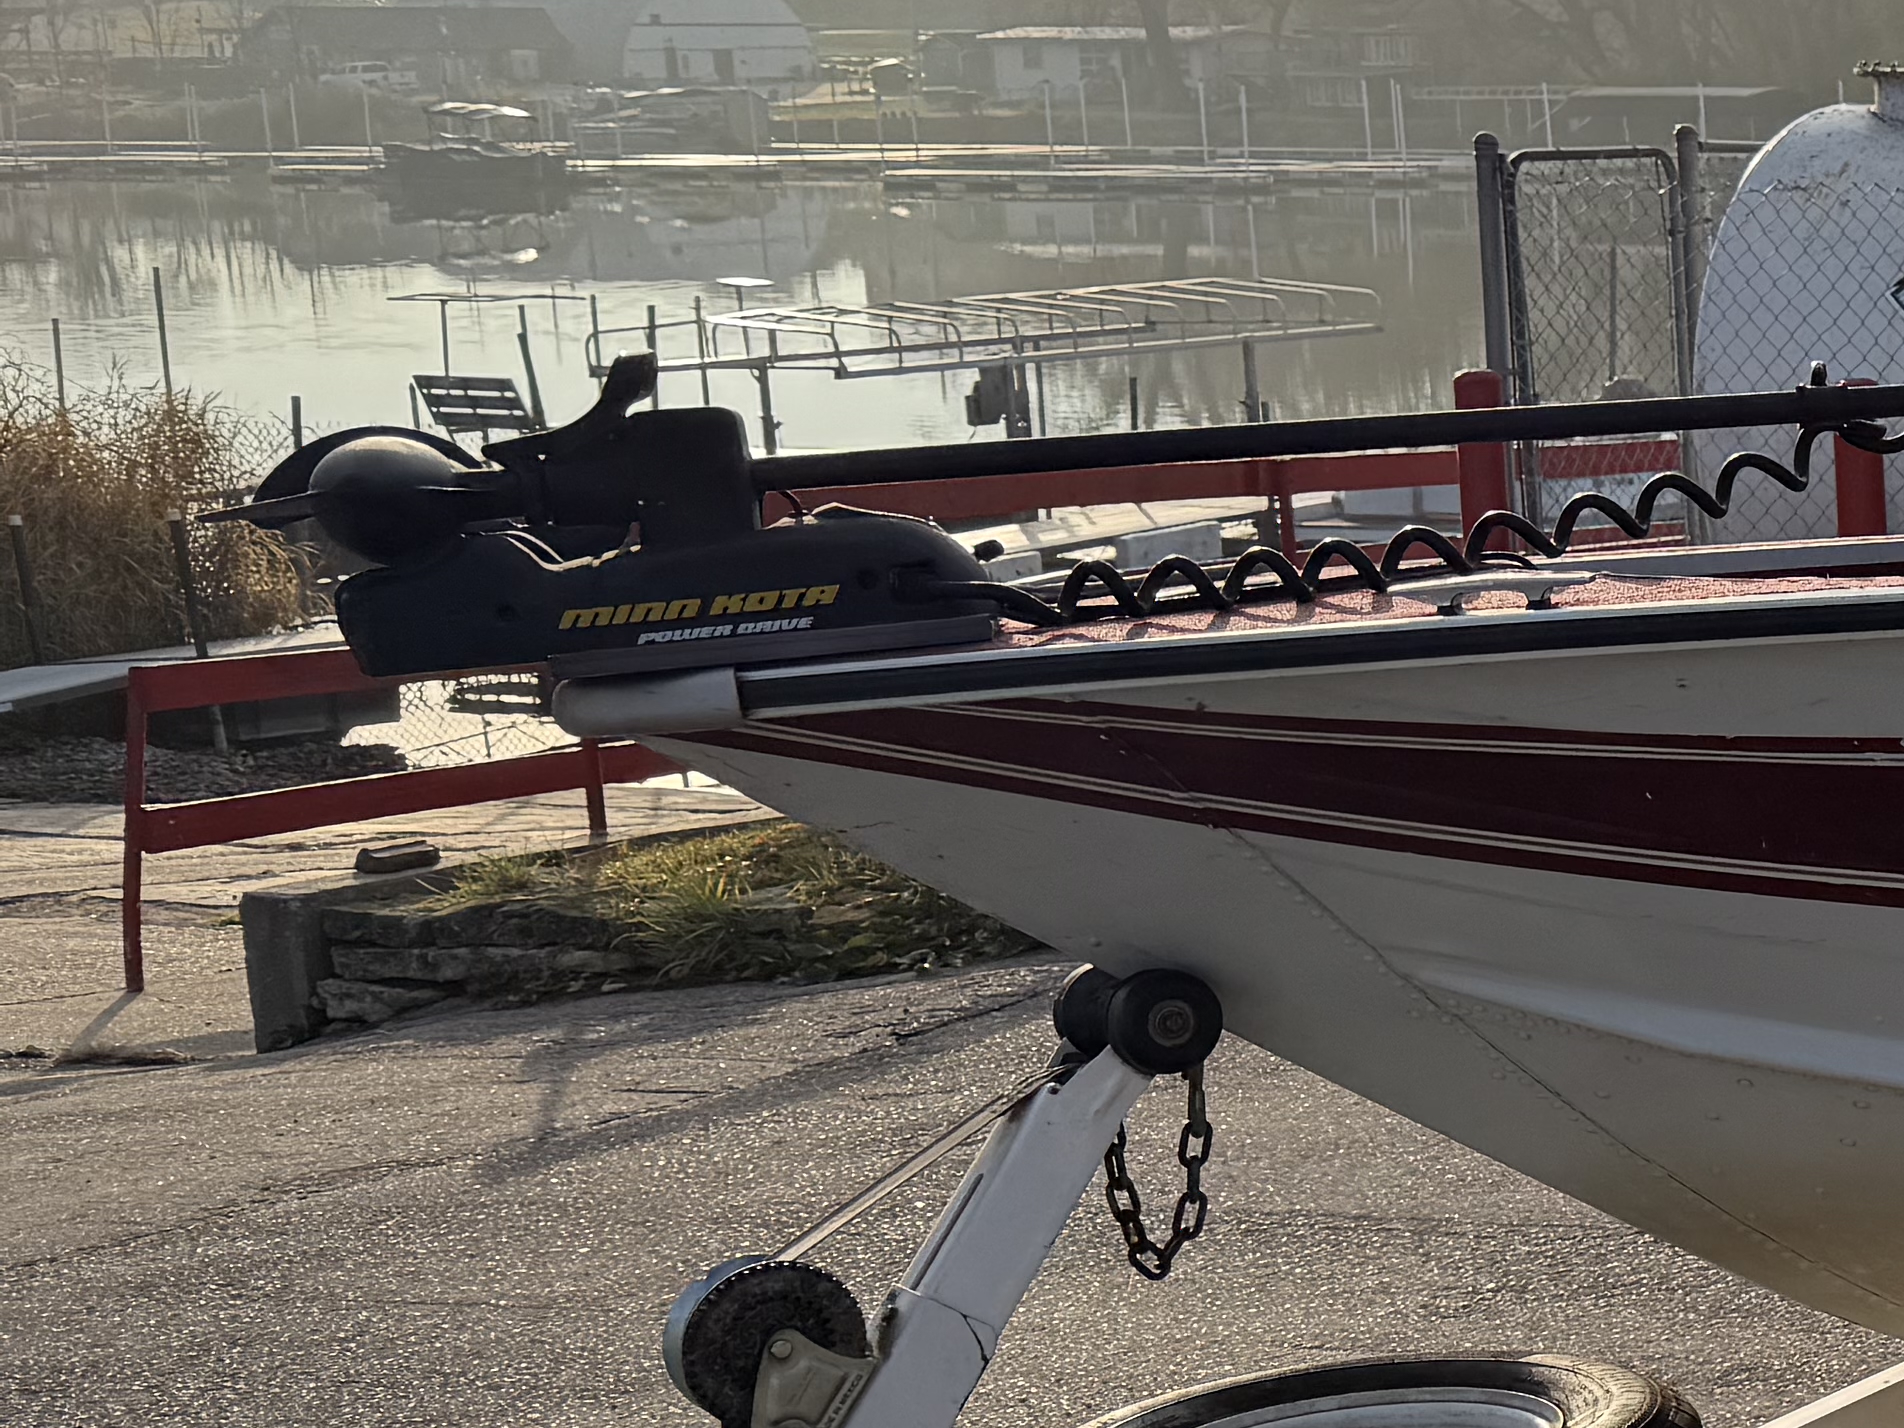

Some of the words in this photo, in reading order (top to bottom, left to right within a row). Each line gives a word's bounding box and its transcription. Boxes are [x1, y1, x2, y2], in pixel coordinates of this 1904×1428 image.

[709, 584, 841, 617] KOTA
[636, 624, 733, 646] POWER
[736, 615, 816, 636] DRIVE
